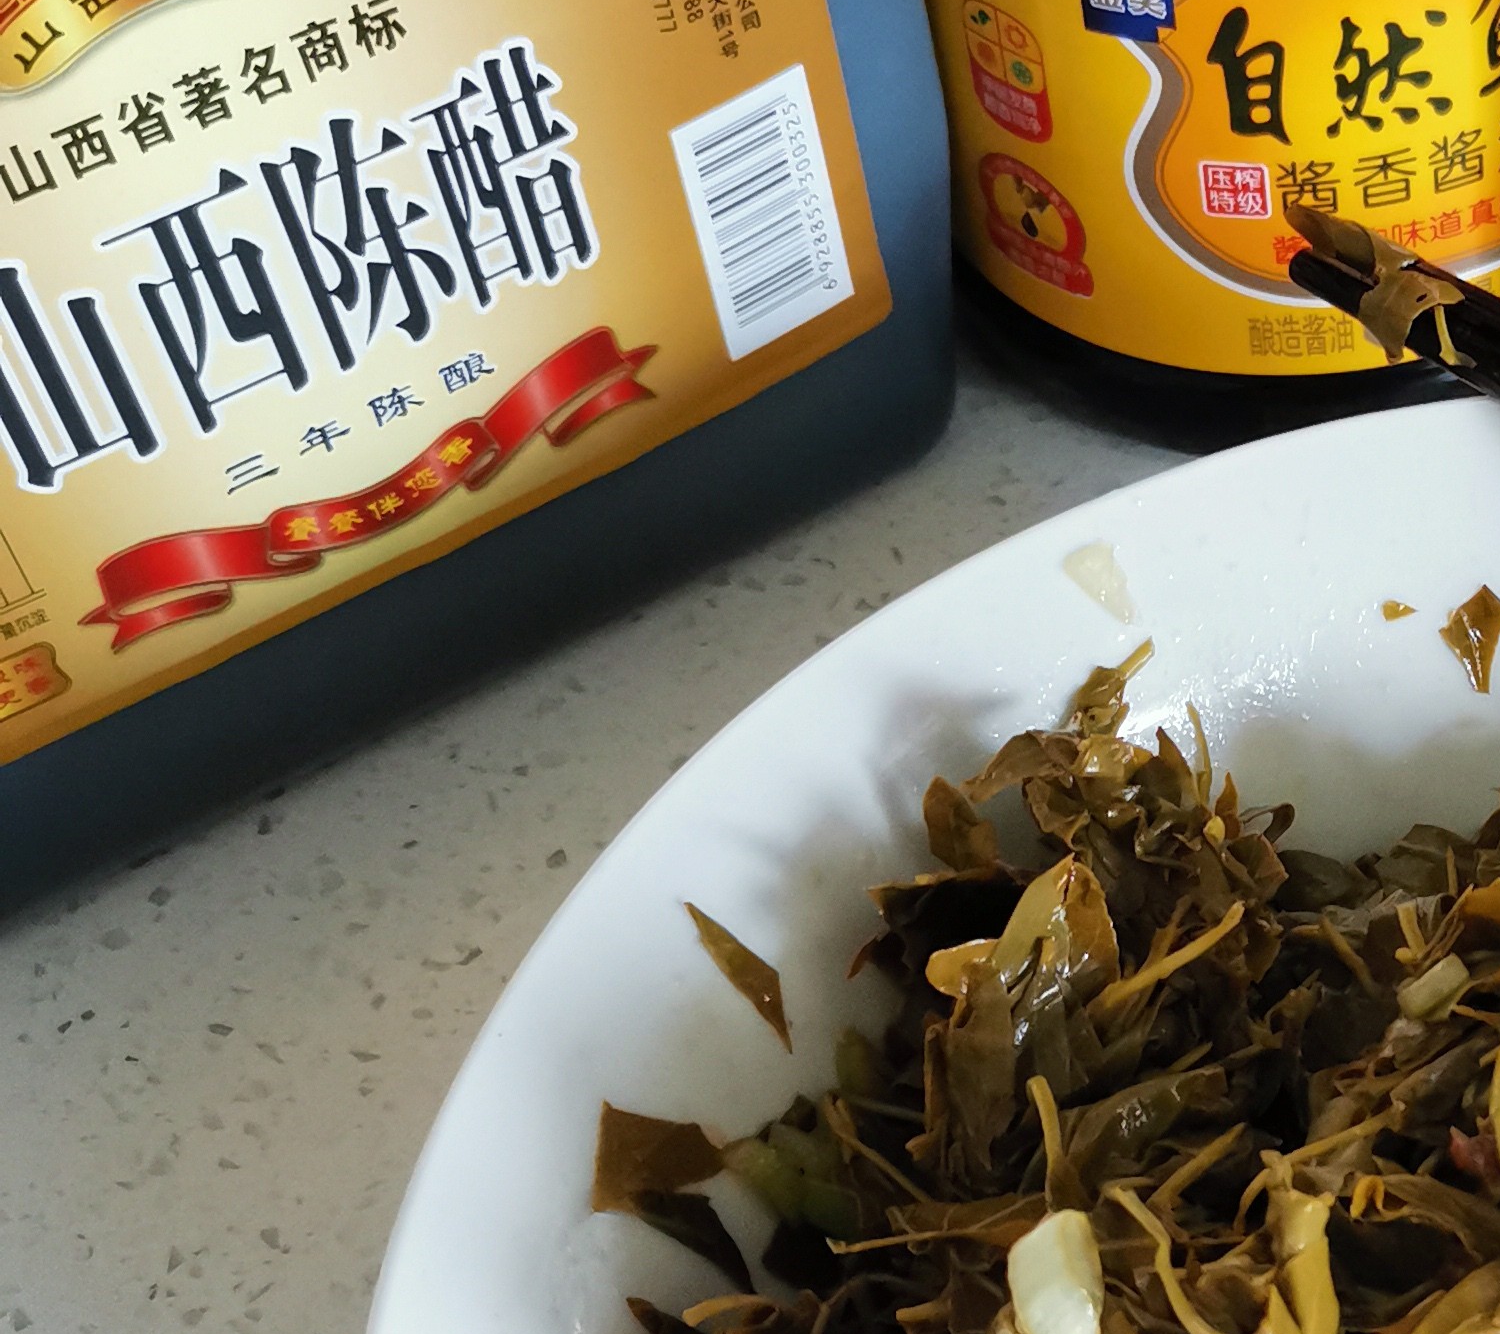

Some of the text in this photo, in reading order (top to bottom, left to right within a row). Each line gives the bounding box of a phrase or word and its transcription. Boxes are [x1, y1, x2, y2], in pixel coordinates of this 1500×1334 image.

[0, 47, 592, 487] 山西陈醋
[1248, 317, 1355, 357] 酿造酱油
[225, 353, 495, 495] 三年陈酿
